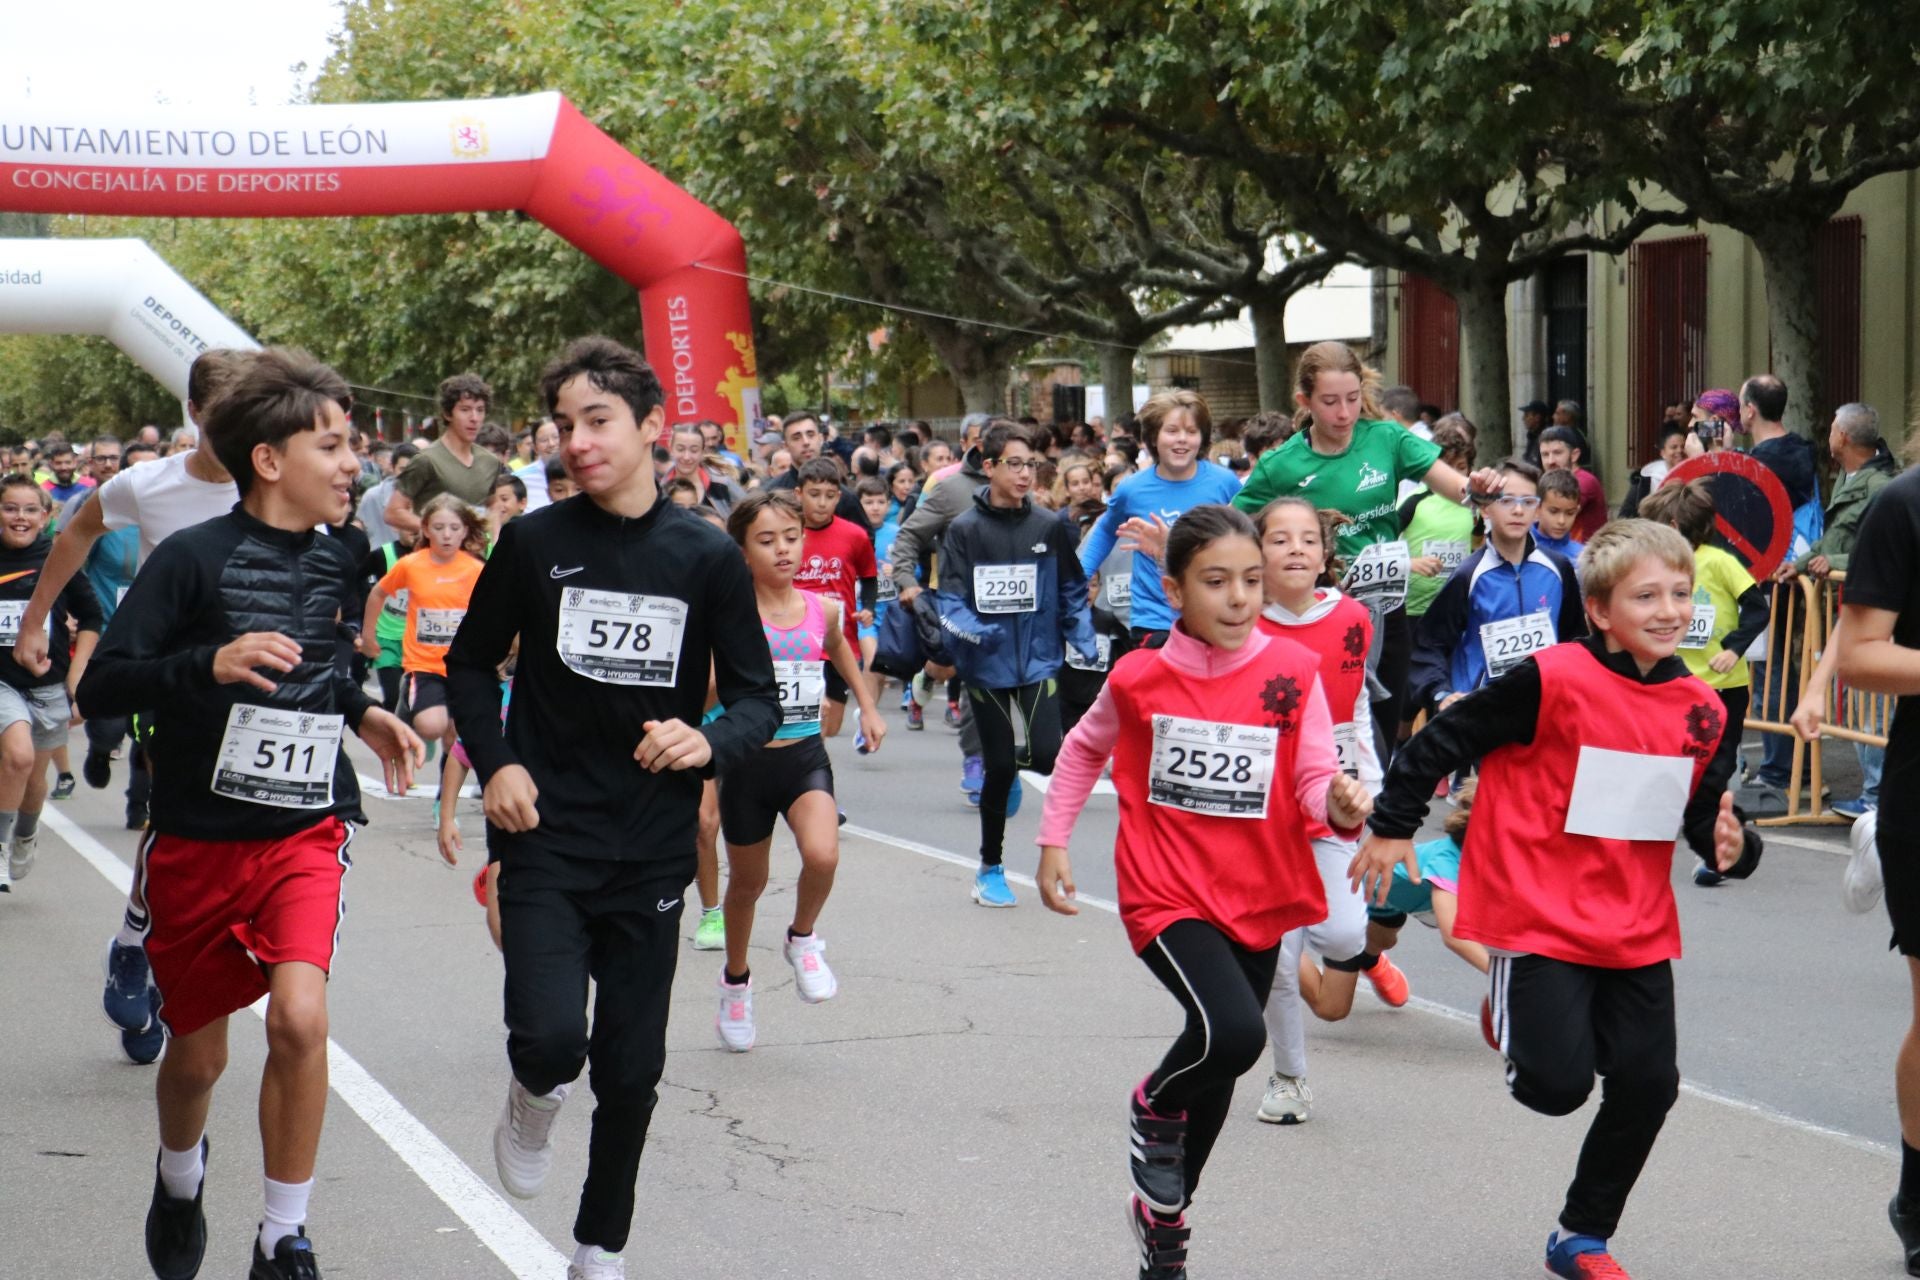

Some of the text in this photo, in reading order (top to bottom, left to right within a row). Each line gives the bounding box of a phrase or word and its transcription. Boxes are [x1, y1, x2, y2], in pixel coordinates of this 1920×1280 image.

[2, 123, 388, 156] UNTAMIENTO DE LEÓN
[11, 167, 341, 193] CONCEJALÍA DE DEPORTES
[667, 295, 697, 416] DEPORTES
[985, 580, 1028, 596] 2290
[587, 619, 652, 652] 578
[1495, 630, 1545, 656] 2292
[253, 739, 315, 775] 511
[1166, 746, 1252, 784] 2528
